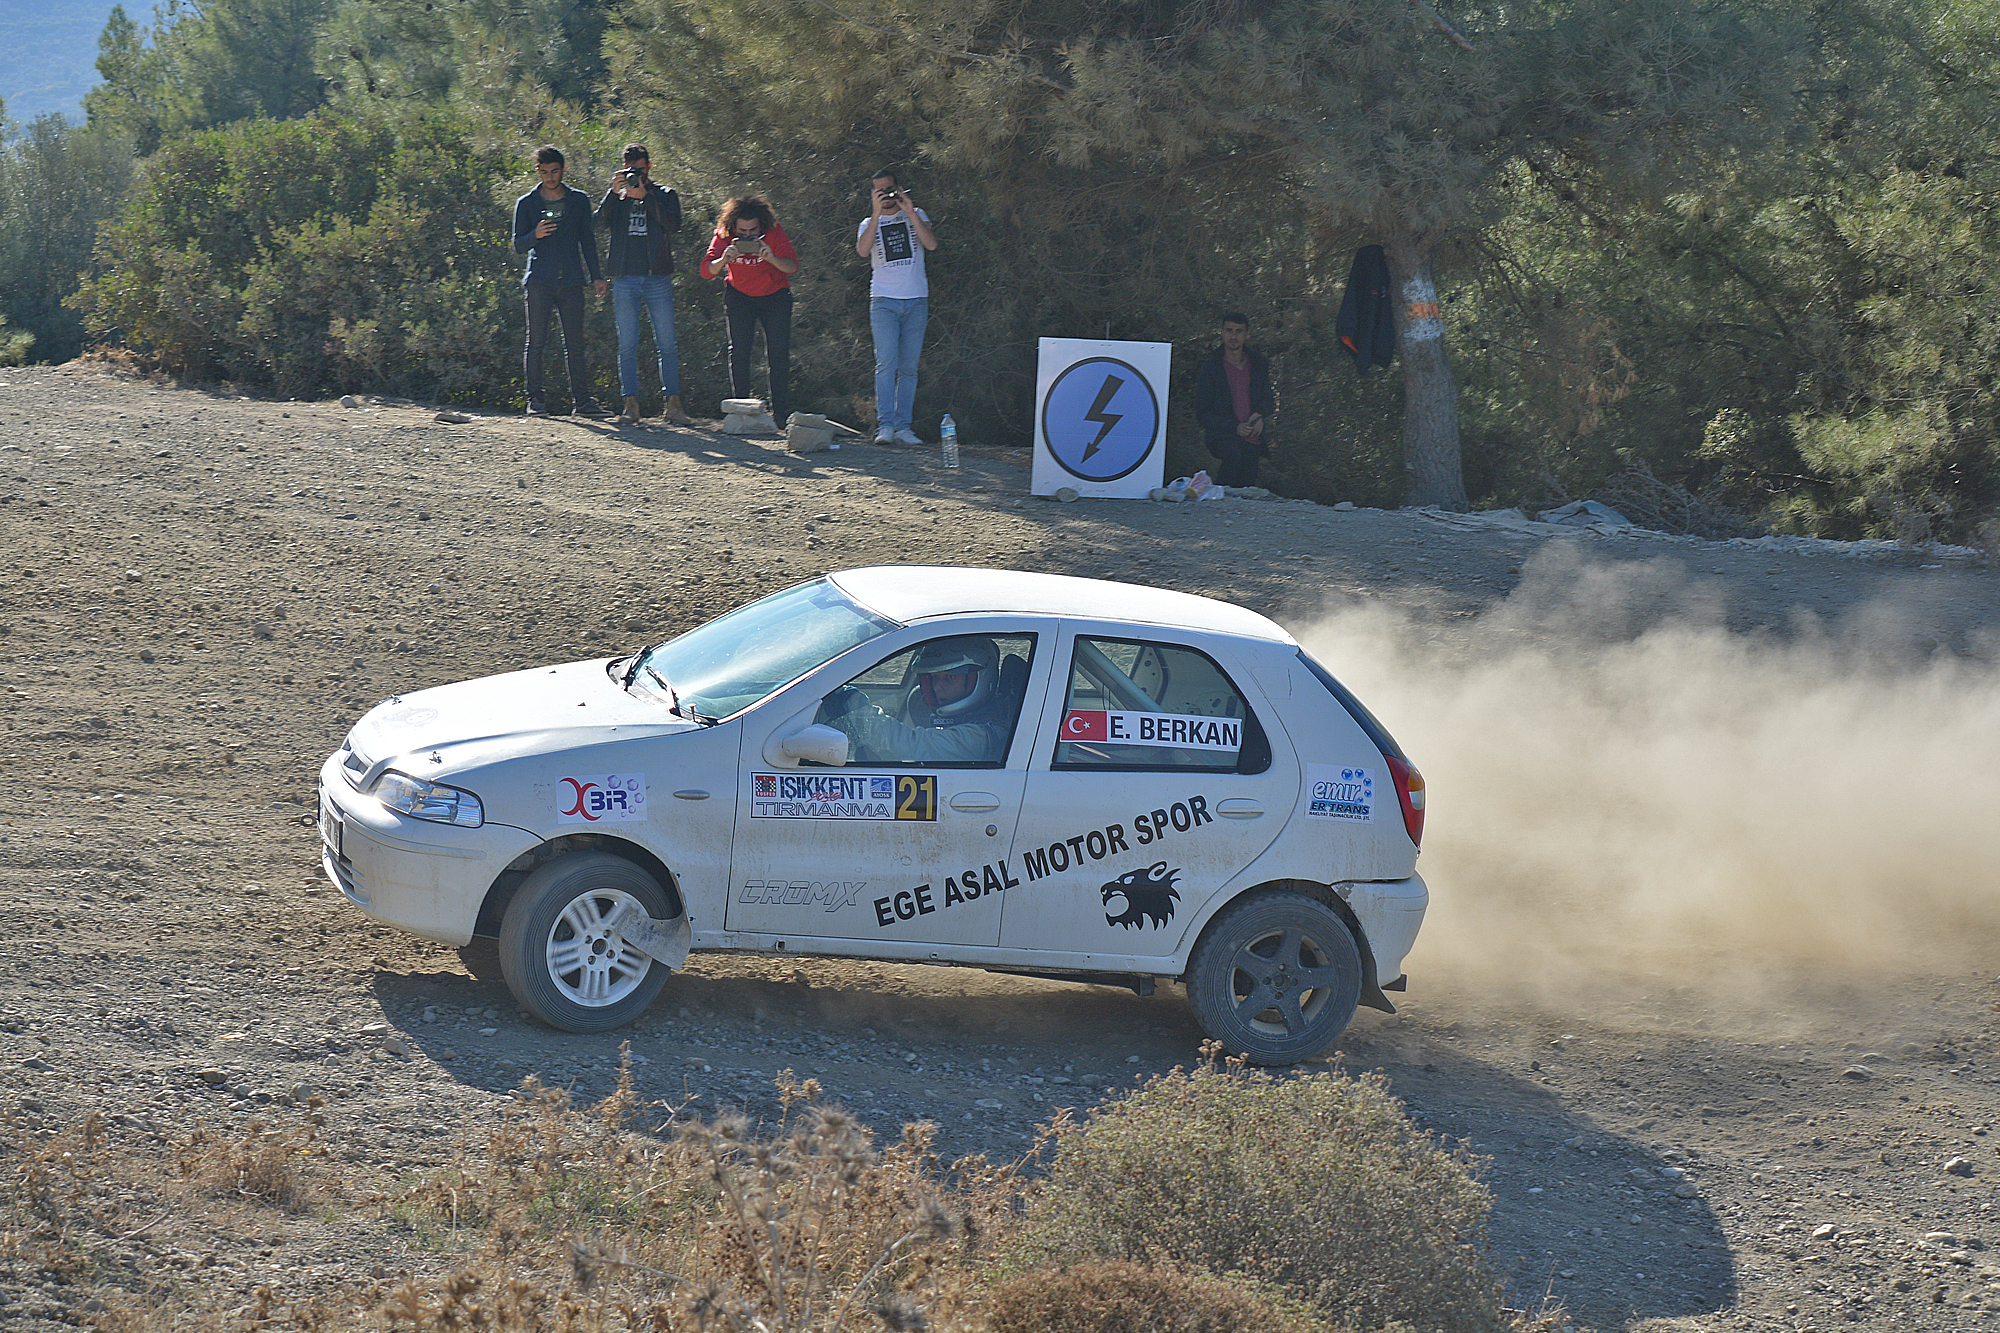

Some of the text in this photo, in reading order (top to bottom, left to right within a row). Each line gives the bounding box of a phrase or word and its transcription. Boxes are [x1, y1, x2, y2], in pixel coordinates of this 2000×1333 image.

[1110, 715, 1238, 747] E. BERKAN
[755, 802, 890, 817] TIRMANMA
[898, 776, 933, 819] 21
[1311, 802, 1370, 815] ER TRANS
[874, 795, 1214, 927] EGE ASAL MOTOR SPOR
[738, 879, 867, 913] CROMX
